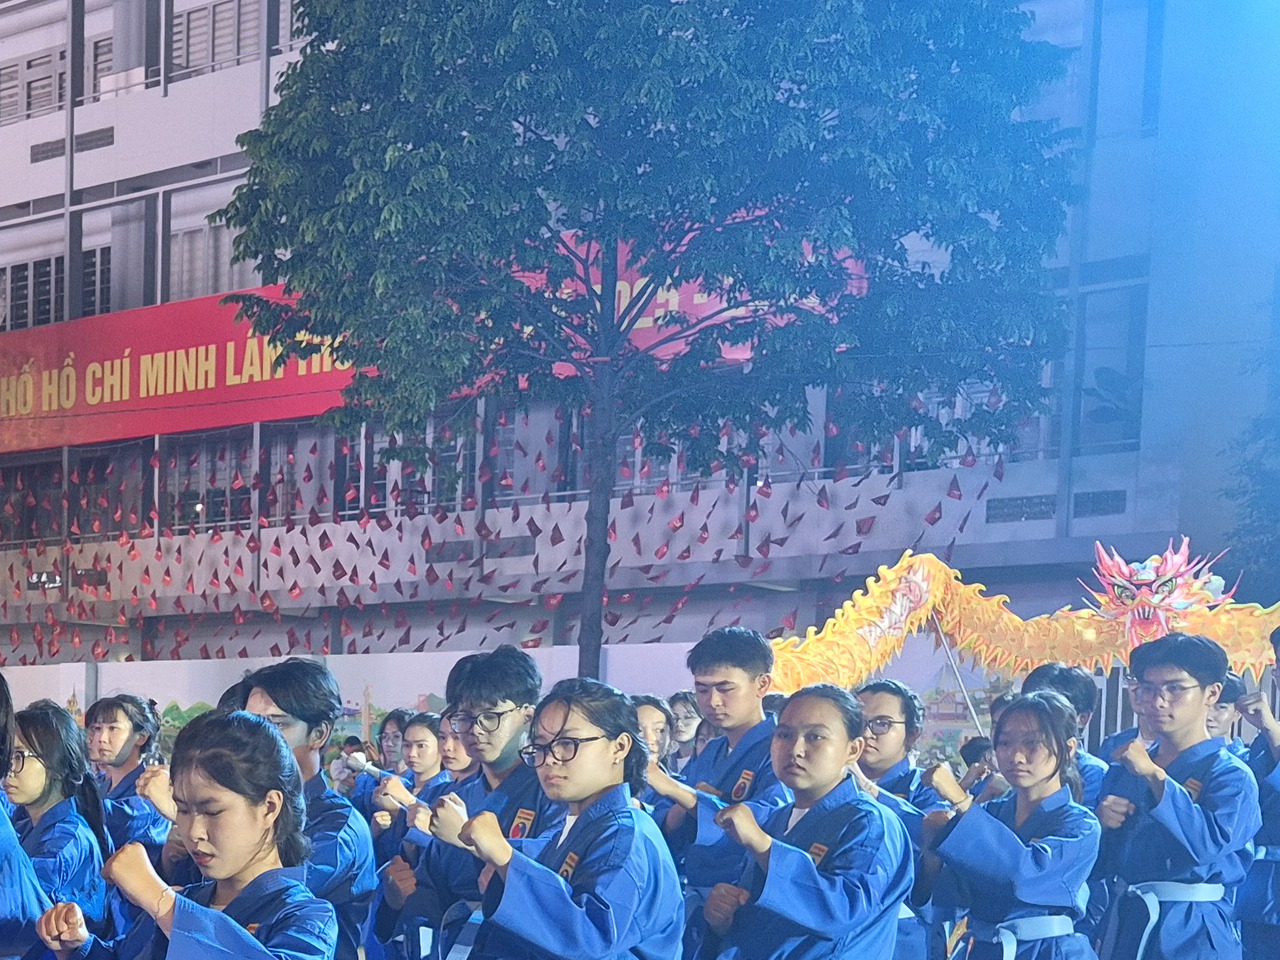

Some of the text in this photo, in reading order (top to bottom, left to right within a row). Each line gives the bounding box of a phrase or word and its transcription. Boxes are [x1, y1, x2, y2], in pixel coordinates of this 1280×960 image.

[41, 351, 77, 412] HỒ
[85, 347, 132, 406] CHÍ
[139, 344, 217, 398] MINH
